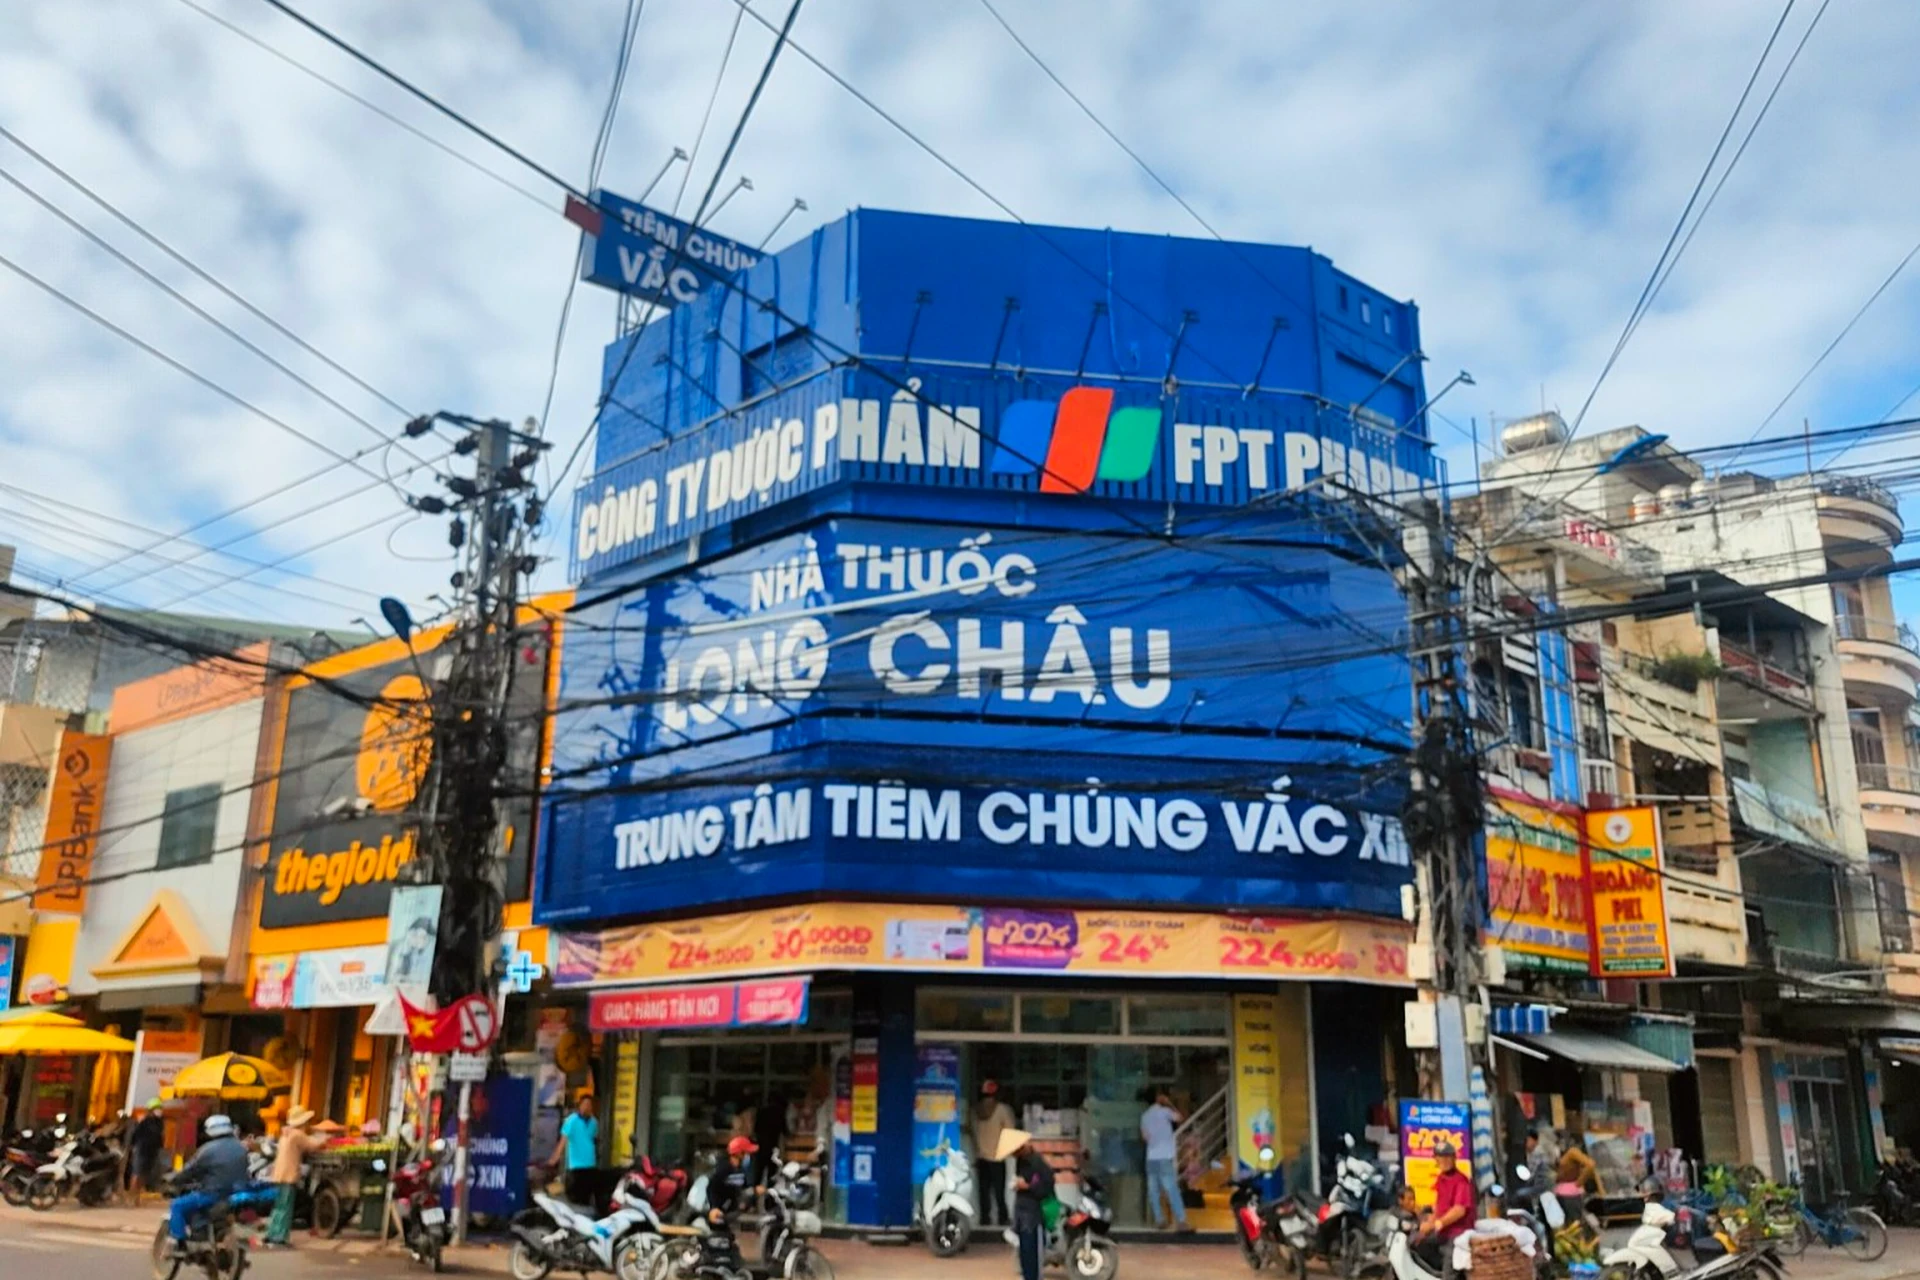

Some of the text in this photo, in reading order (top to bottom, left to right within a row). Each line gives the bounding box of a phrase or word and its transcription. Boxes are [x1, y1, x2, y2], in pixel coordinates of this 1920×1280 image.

[577, 479, 659, 561] CÔNG
[665, 458, 706, 527] TY
[707, 417, 804, 512] DƯỢC
[813, 377, 981, 470] PHẨM
[1174, 422, 1274, 489] FPT
[751, 531, 1037, 612] NHÀ THUỐC
[661, 604, 1171, 734] LONG CHÂU
[54, 782, 97, 901] LPBank
[614, 805, 724, 871] TRUNG
[731, 783, 812, 852] TÂM
[823, 779, 962, 841] TIÊM
[977, 776, 1209, 852] CHỦNG
[1220, 774, 1349, 857] VẮC
[1098, 931, 1170, 964] 24%
[479, 1164, 507, 1189] XIN
